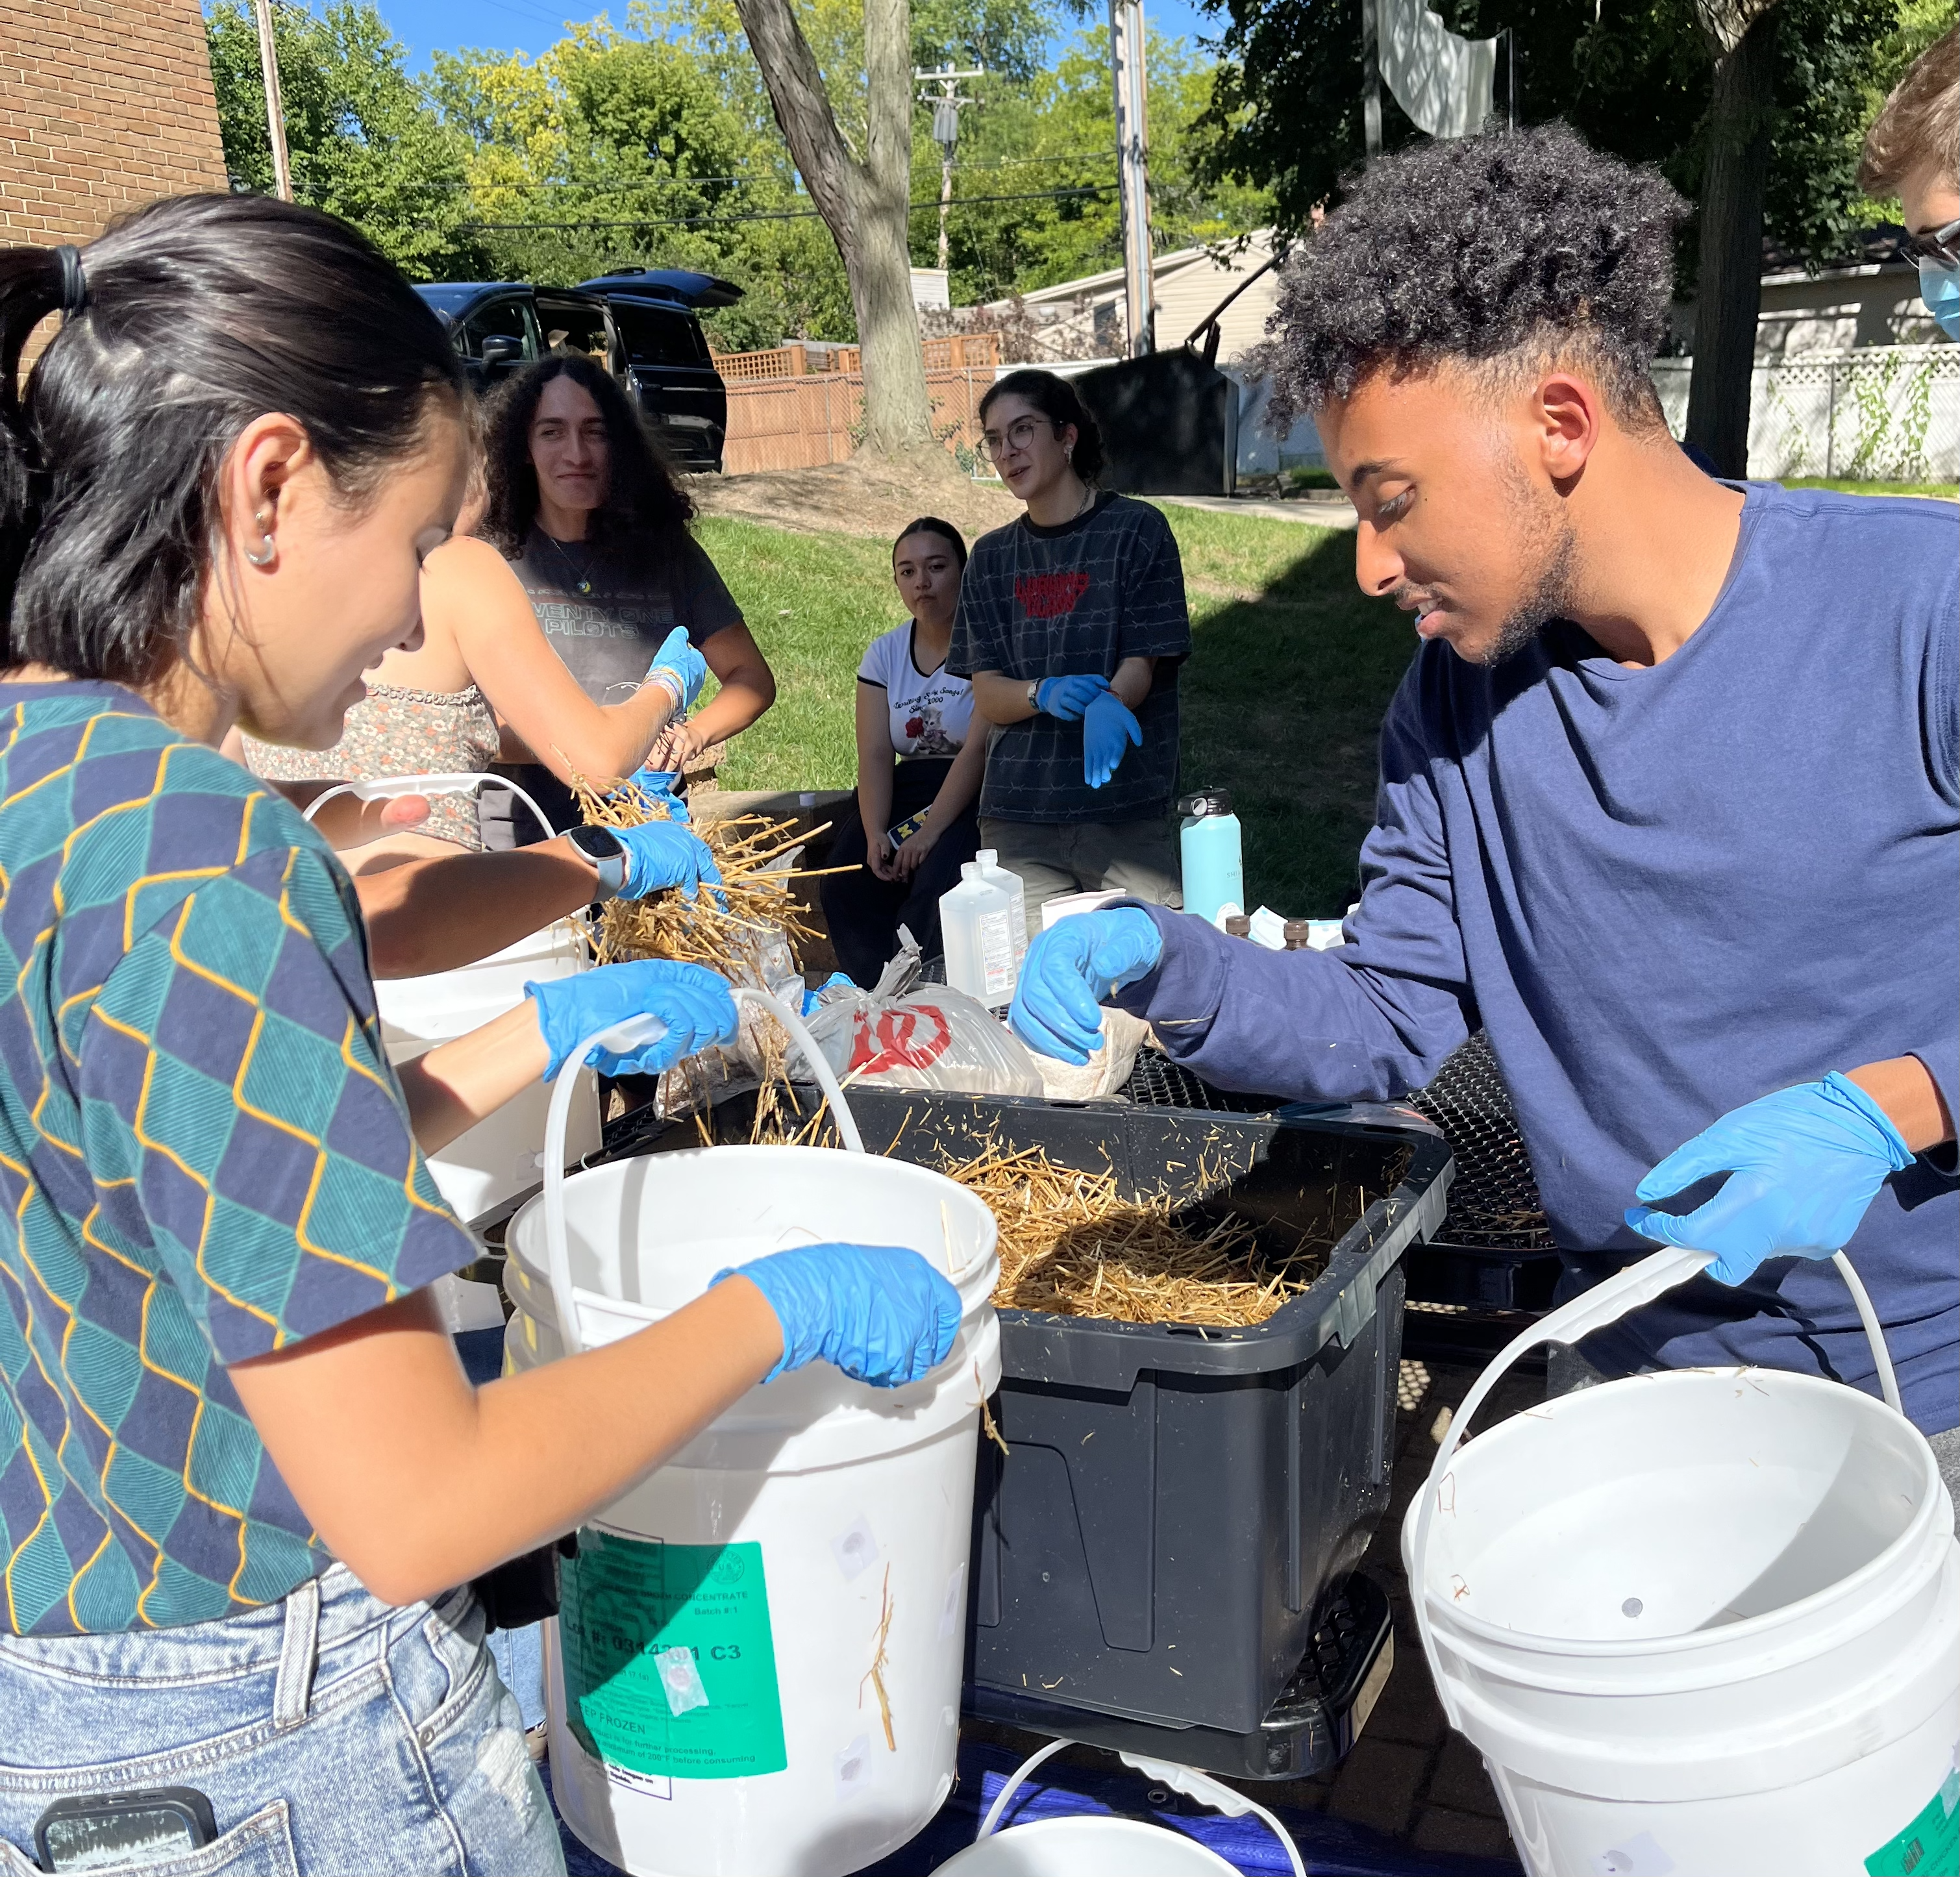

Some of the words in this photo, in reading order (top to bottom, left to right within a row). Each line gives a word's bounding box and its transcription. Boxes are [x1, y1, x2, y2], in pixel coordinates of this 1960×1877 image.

[532, 602, 614, 622] WENTY
[674, 1591, 749, 1602] CONCENTRATE
[694, 1606, 721, 1616] Batch
[710, 1645, 741, 1661] C3
[599, 1711, 646, 1734] FROZEN
[634, 1740, 662, 1752] further
[664, 1747, 716, 1756] processing,
[673, 1756, 701, 1765] before
[704, 1754, 756, 1765] consuming
[1930, 1834, 1958, 1871] CHICKEN
